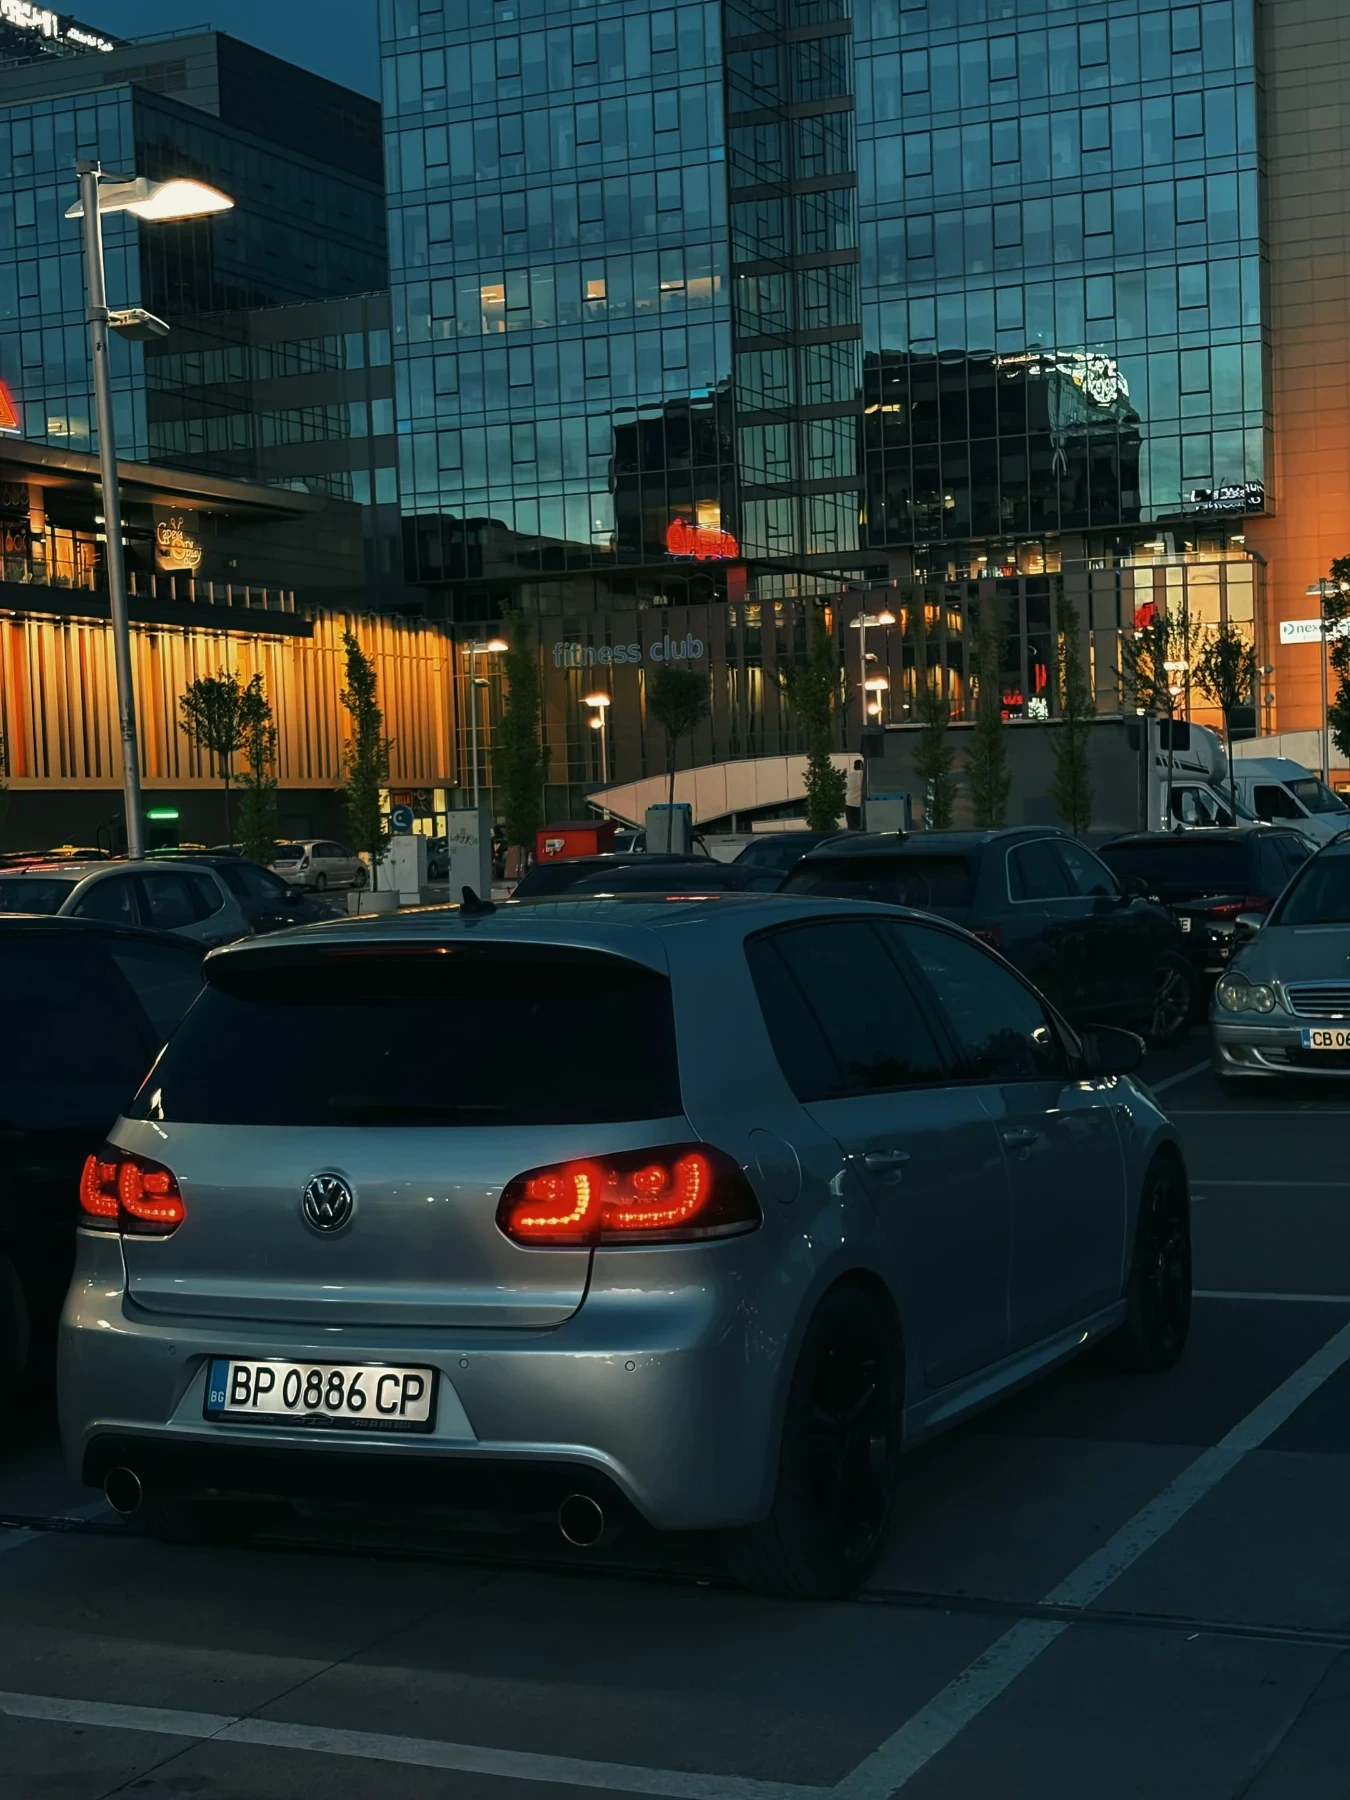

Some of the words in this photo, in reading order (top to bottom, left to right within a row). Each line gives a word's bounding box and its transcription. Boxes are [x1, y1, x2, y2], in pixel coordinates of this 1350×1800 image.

[552, 642, 642, 668] fitness
[650, 632, 704, 661] club
[1312, 1031, 1333, 1047] CB
[210, 1390, 226, 1403] BG
[230, 1365, 275, 1407] BP
[282, 1368, 367, 1412] 0886
[375, 1373, 425, 1415] CP
